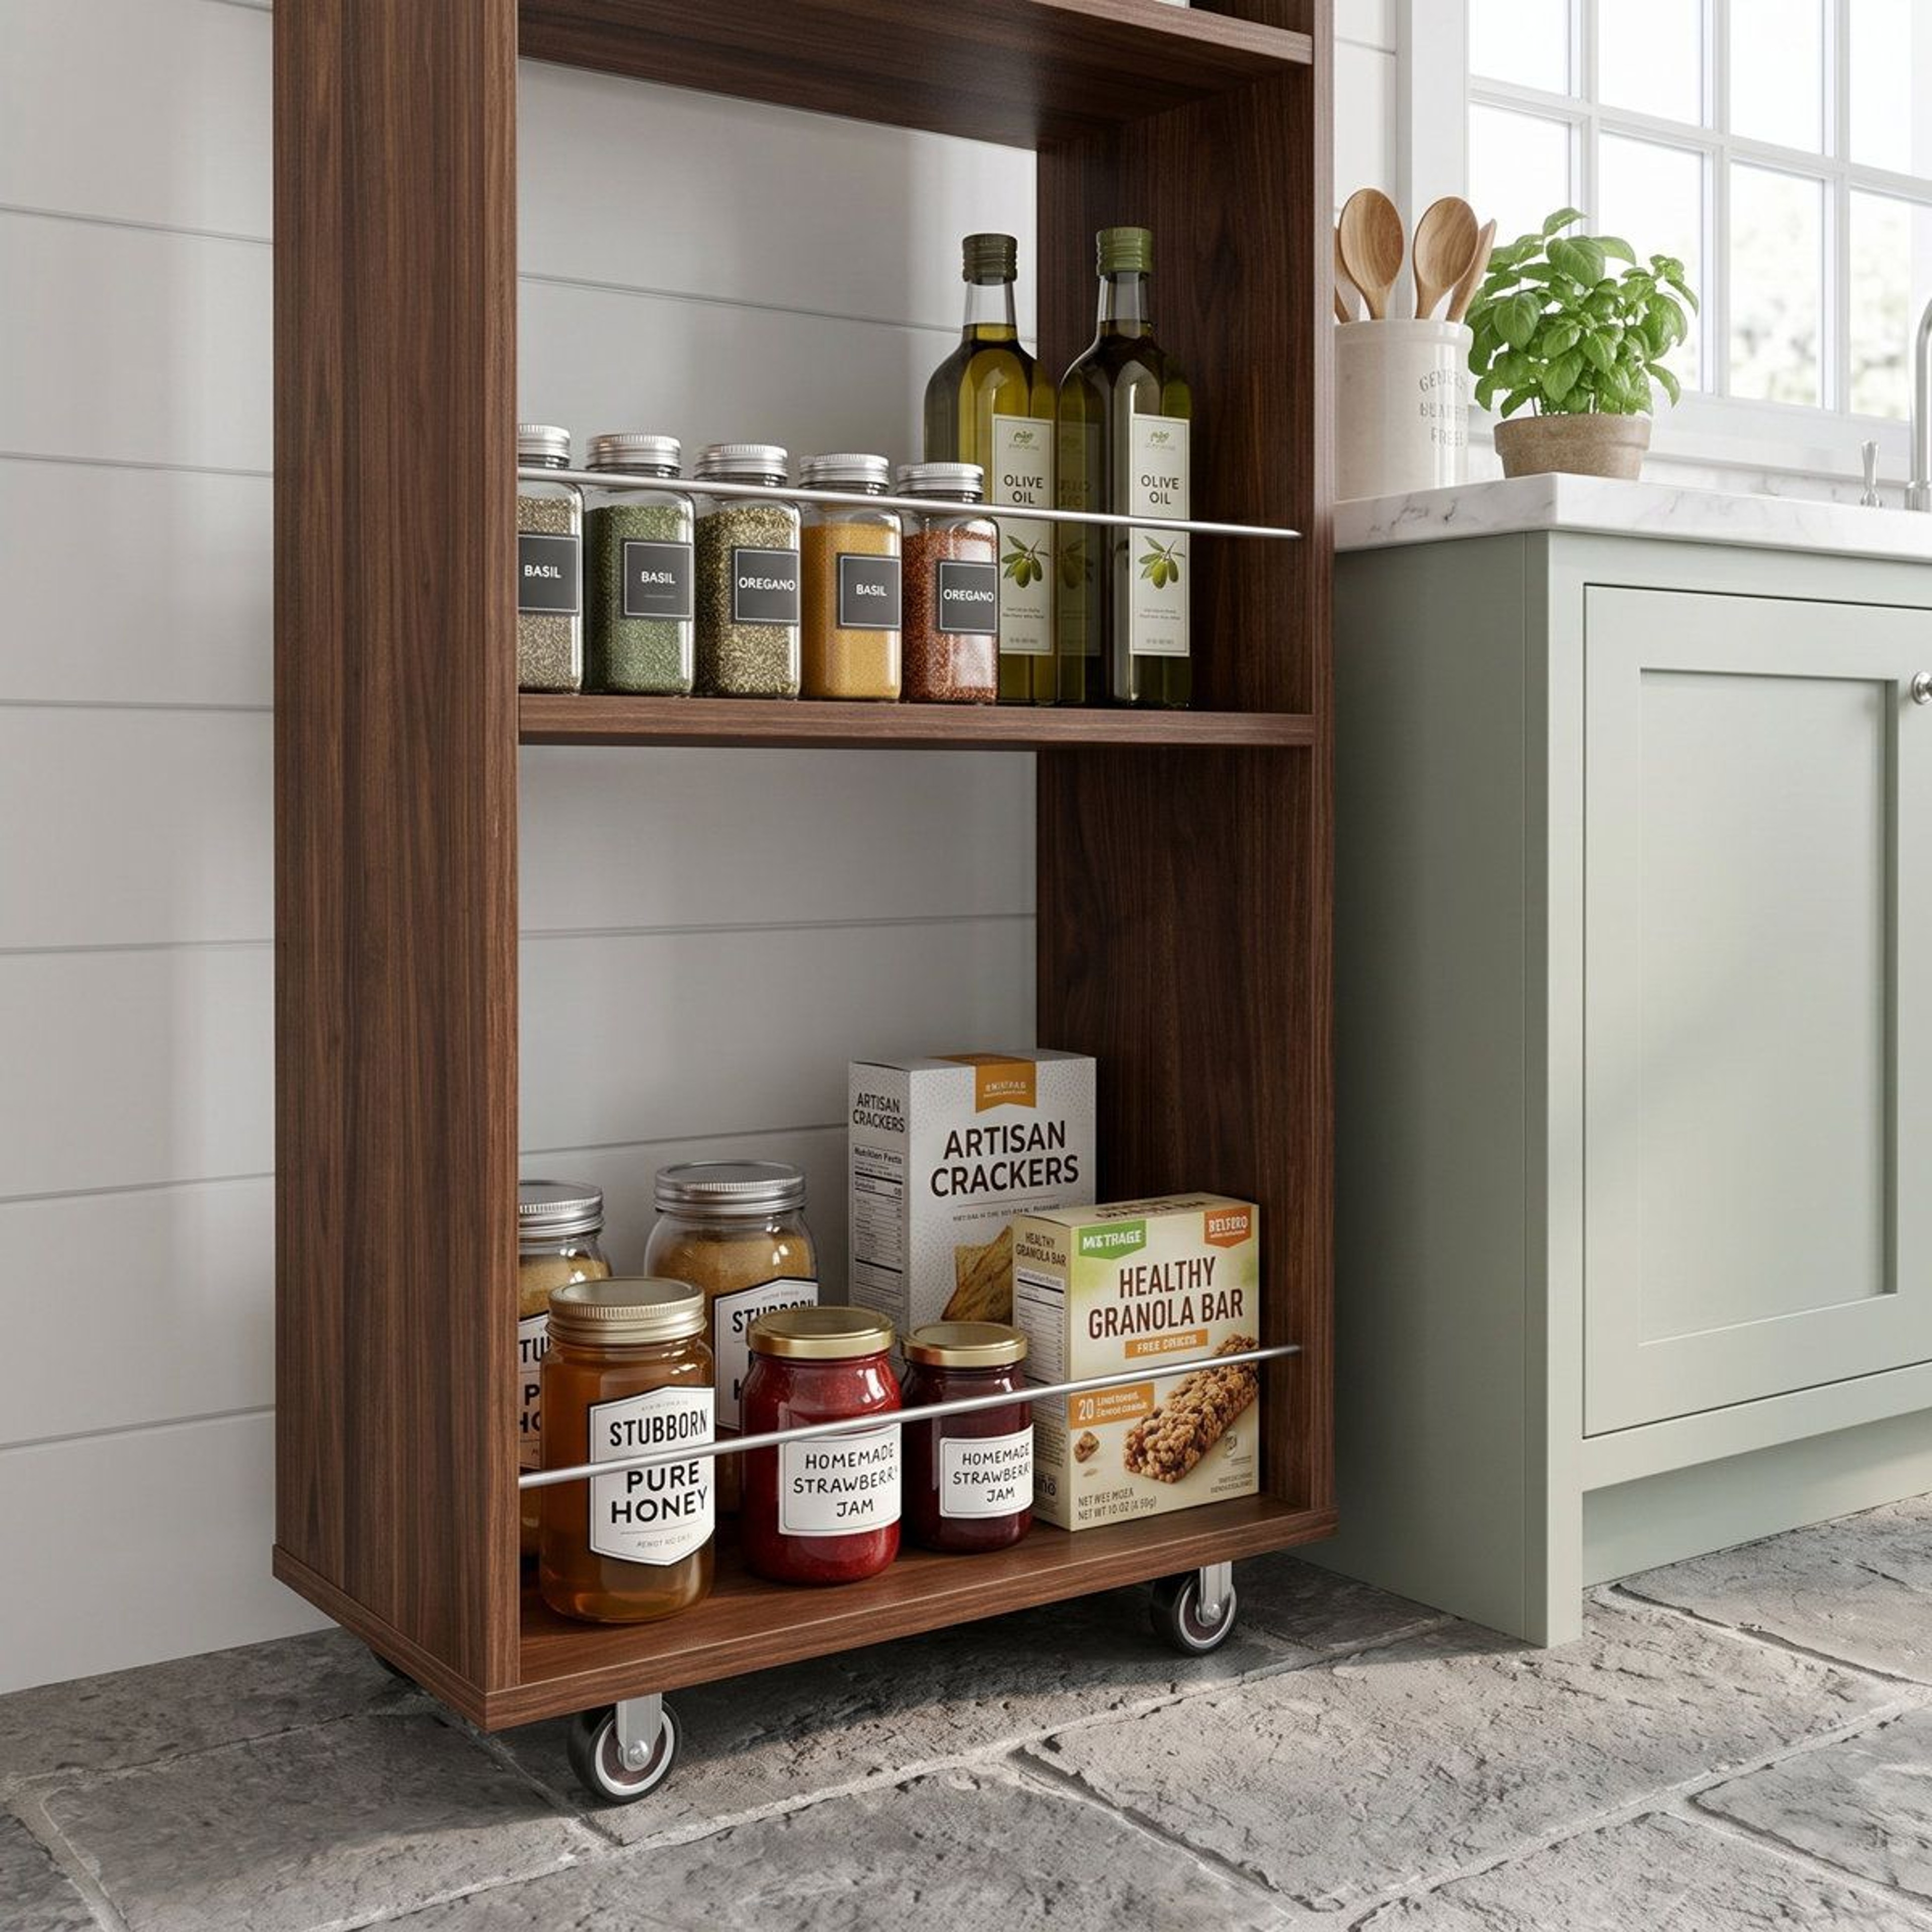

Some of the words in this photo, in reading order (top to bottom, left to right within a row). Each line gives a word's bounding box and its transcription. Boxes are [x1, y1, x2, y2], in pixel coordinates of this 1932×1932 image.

[1004, 474, 1043, 489] OLIVE
[1141, 474, 1179, 490] OLIVE
[1012, 490, 1035, 504] OIL
[1149, 491, 1171, 504] OIL
[524, 565, 561, 579] BASIL
[641, 571, 676, 584] BASIL
[739, 577, 795, 591] OREGANO
[856, 584, 887, 597] BASIL
[943, 588, 994, 602] OREGANO
[856, 1092, 901, 1113] ARTISAN
[853, 1109, 905, 1133] CRACKERS
[943, 1120, 1065, 1160] ARTISAN
[931, 1154, 1079, 1197] CRACKERS
[1120, 1256, 1216, 1299] HEALTHY
[1089, 1296, 1195, 1339] GRANOLA
[1201, 1288, 1243, 1322] BAR
[1137, 1340, 1160, 1353] FREE
[1079, 1398, 1094, 1421] 20
[610, 1409, 707, 1446] STUBBORN
[805, 1442, 894, 1469] HOMEMADE
[962, 1442, 1029, 1466] HOMEMADE
[627, 1461, 699, 1494] PURE
[793, 1466, 897, 1494] STRAWBERR
[952, 1462, 1030, 1485] STRAWBERR
[611, 1486, 707, 1523] HONEY
[987, 1487, 1015, 1503] JAM
[1078, 1495, 1093, 1507] NET
[837, 1499, 873, 1517] JAM
[1078, 1508, 1092, 1520] NET
